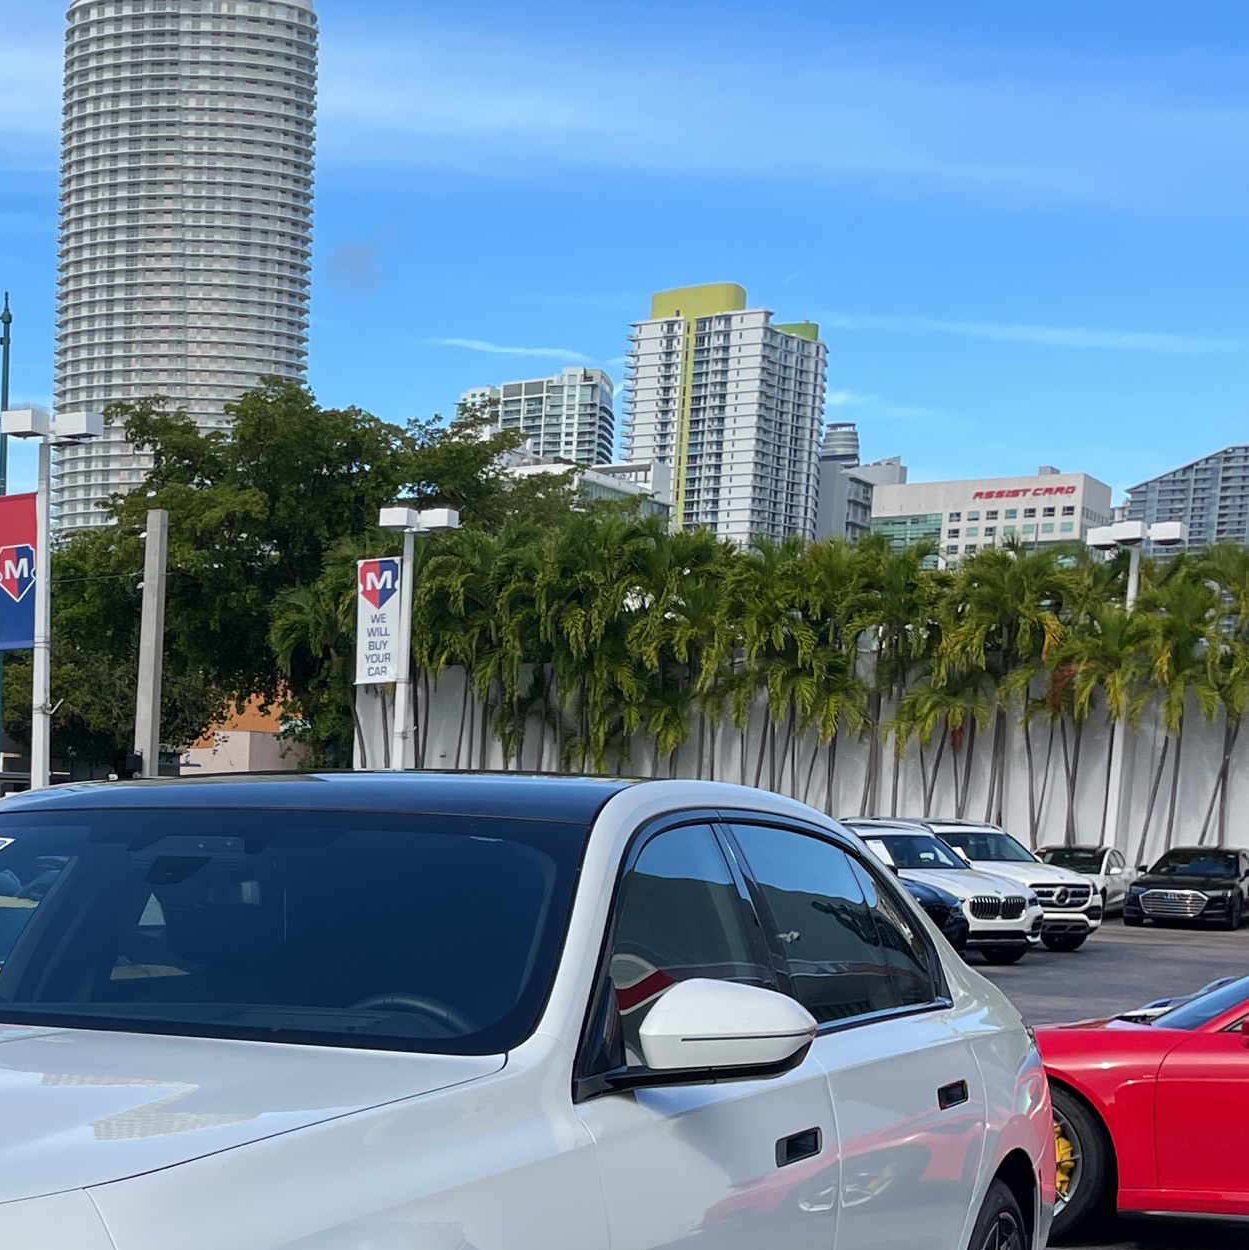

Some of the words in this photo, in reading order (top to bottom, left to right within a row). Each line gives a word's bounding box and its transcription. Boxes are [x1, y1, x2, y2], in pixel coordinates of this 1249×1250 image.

[4, 558, 29, 580] M
[366, 570, 392, 591] M
[370, 613, 387, 624] WE
[366, 627, 390, 638] WILL
[368, 640, 388, 651] BUY
[365, 653, 391, 664] YOUR
[367, 666, 387, 677] CAR
